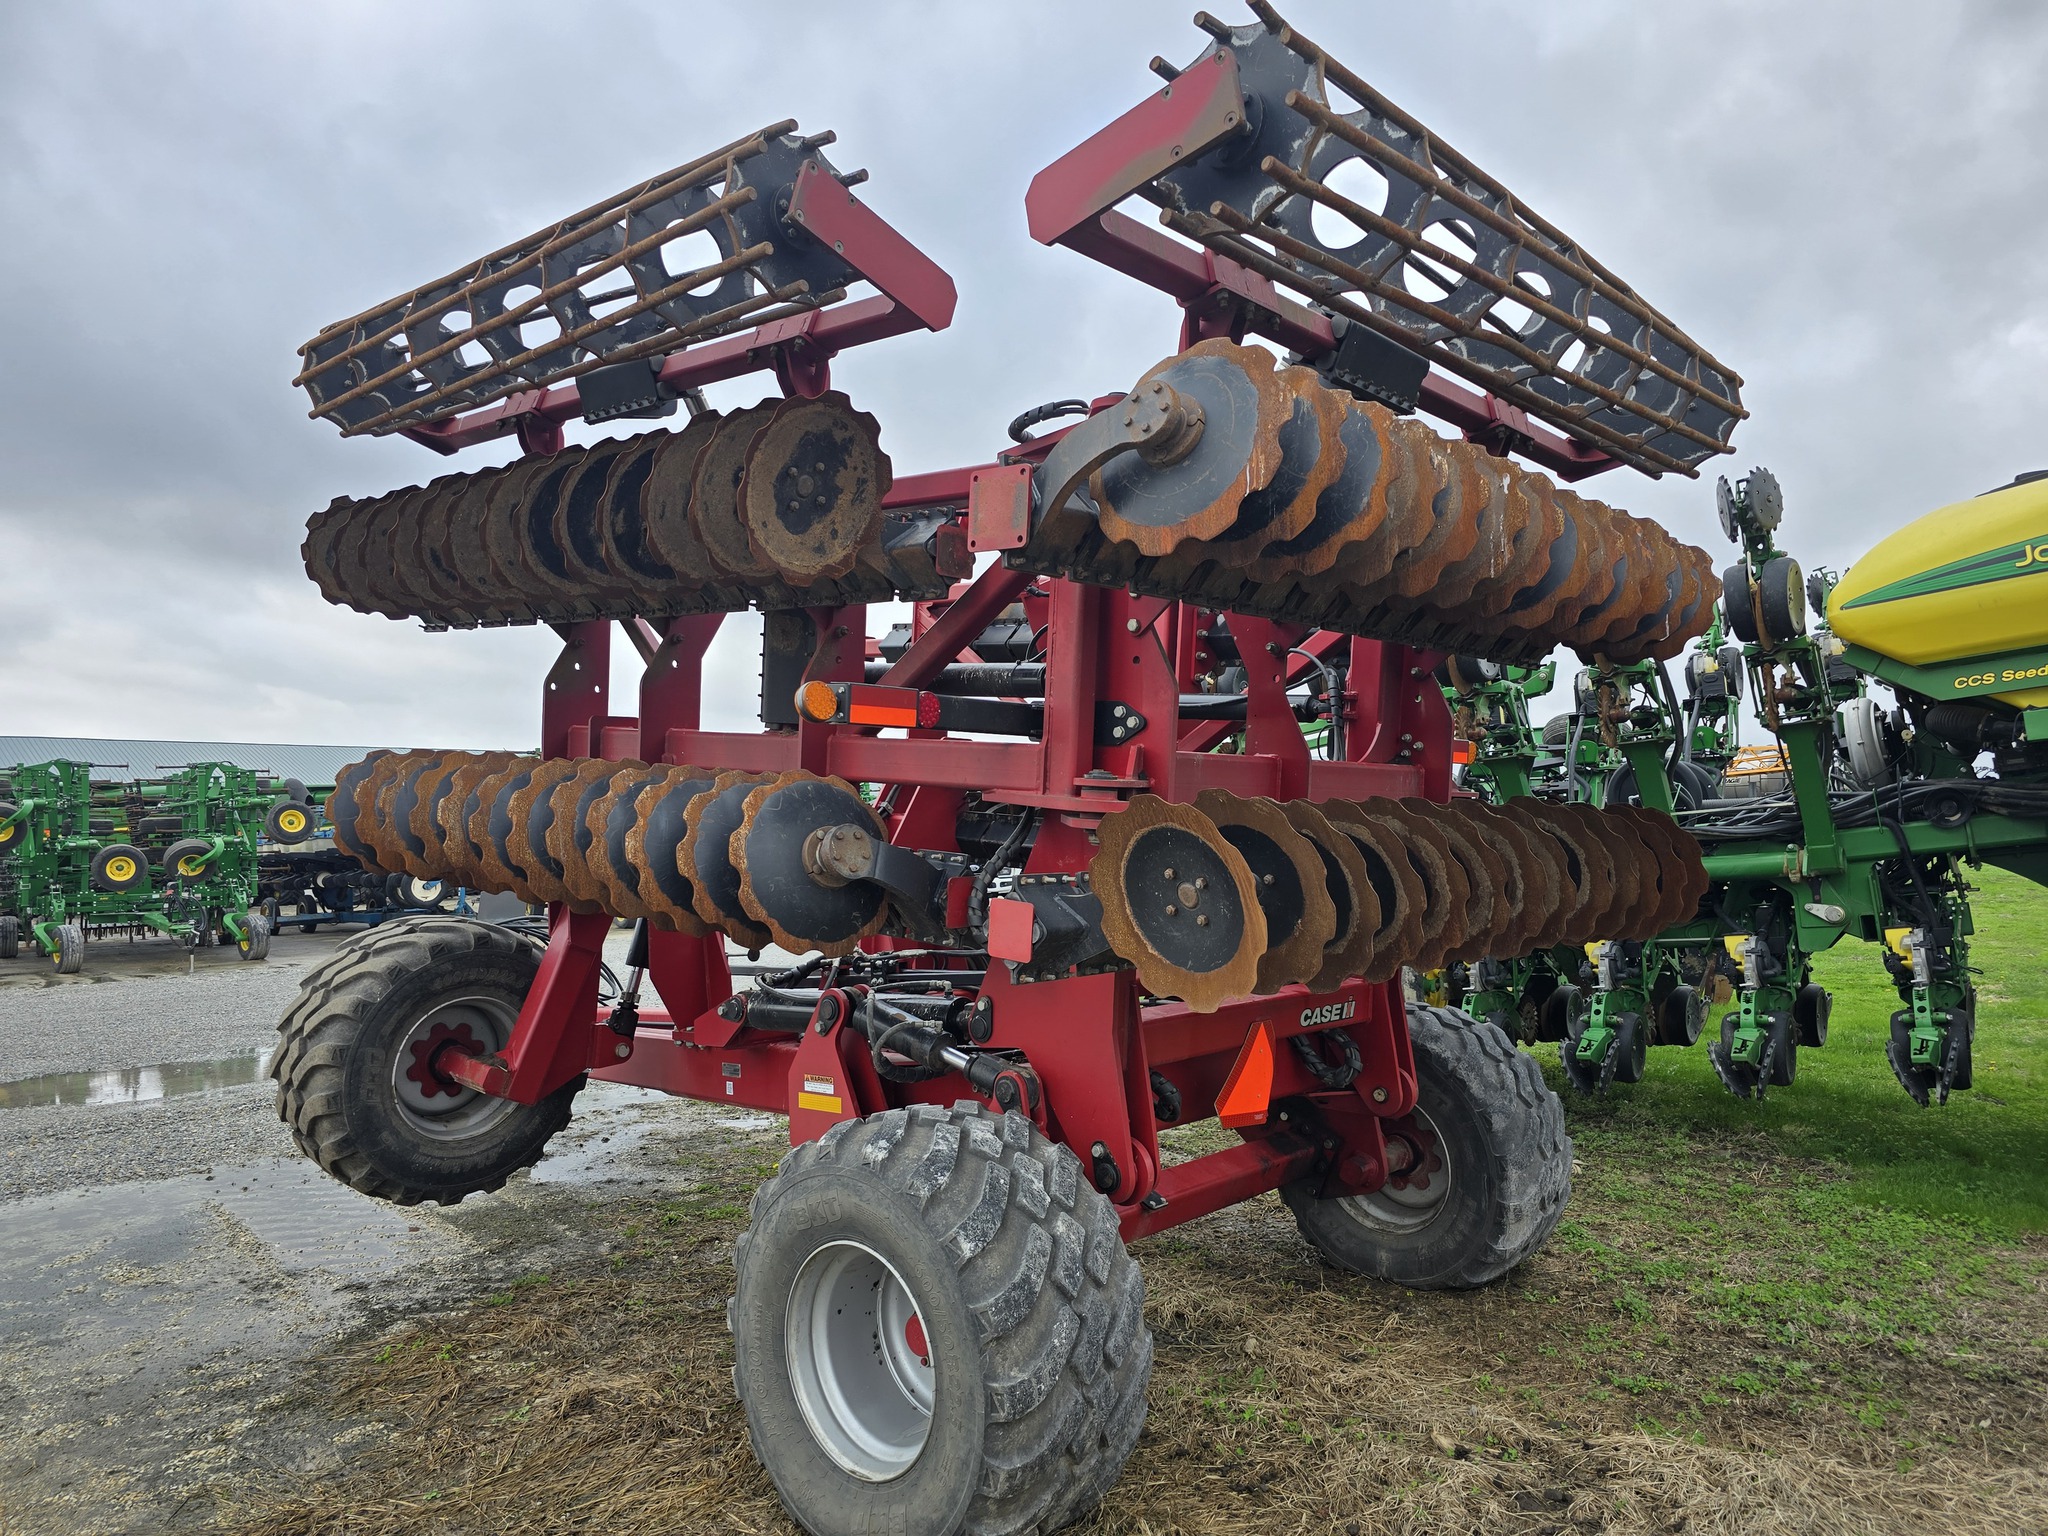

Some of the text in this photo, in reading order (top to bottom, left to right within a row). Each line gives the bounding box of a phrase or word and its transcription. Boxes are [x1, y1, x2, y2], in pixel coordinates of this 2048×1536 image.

[1954, 664, 2048, 689] CCS Seed
[1300, 1003, 1342, 1027] CASE
[810, 1075, 832, 1084] WARNING
[791, 1193, 839, 1228] BKT
